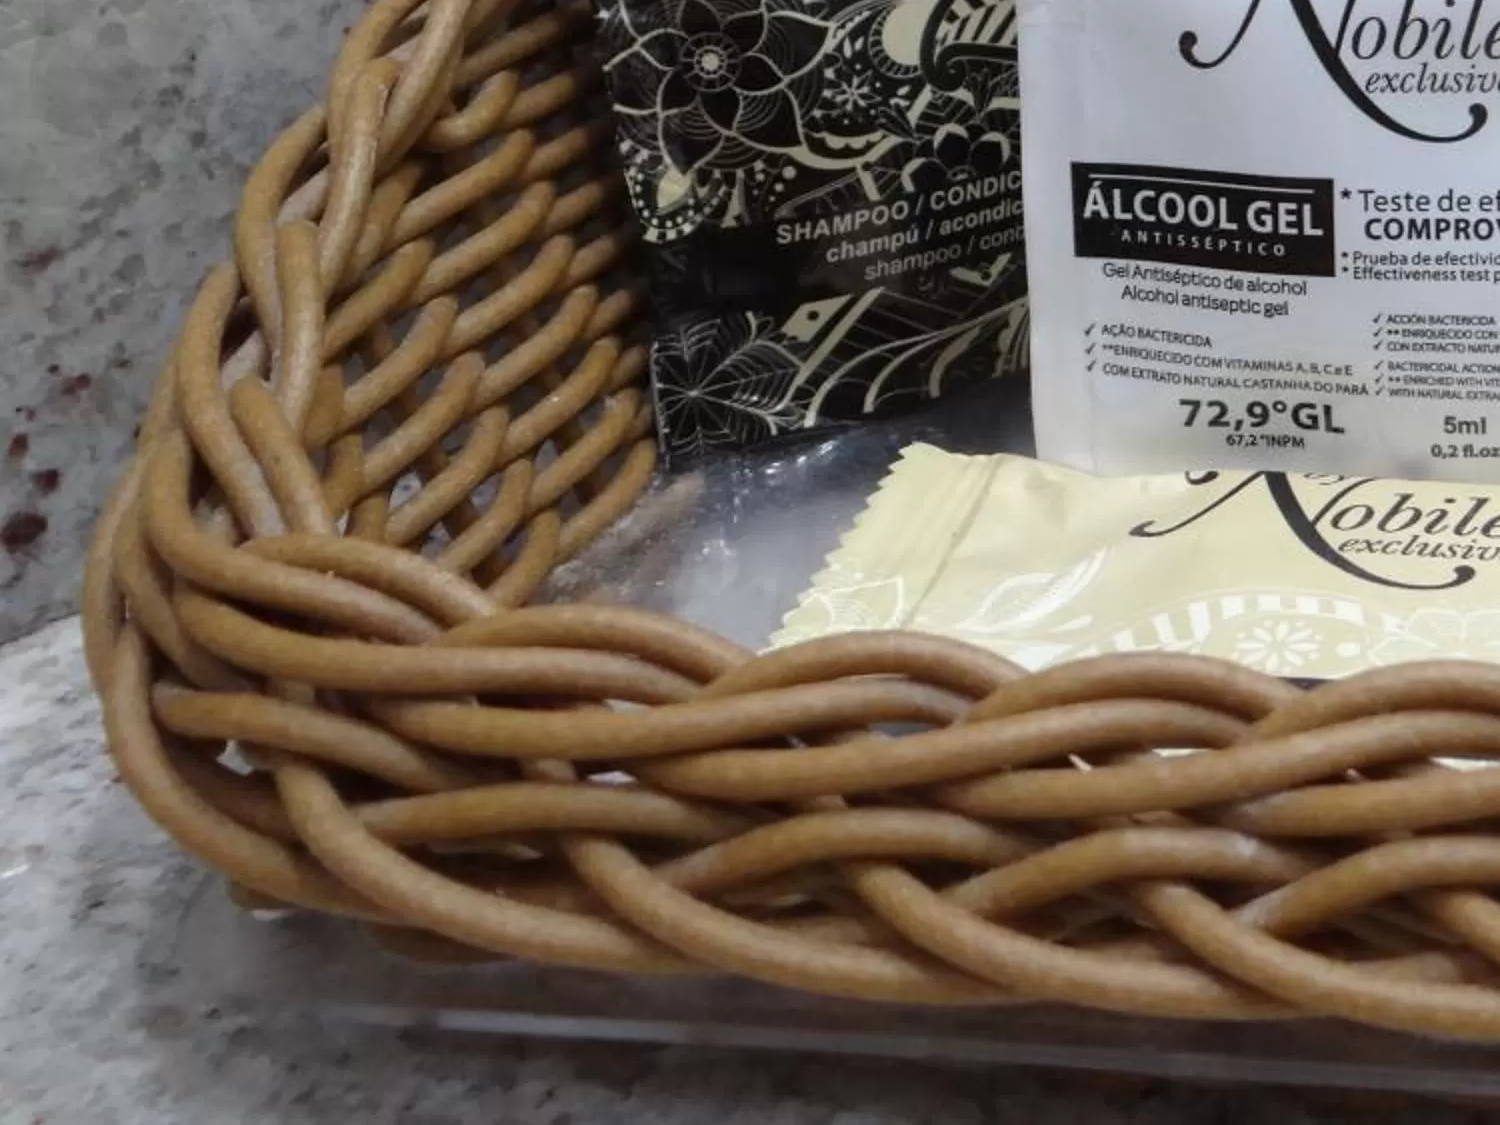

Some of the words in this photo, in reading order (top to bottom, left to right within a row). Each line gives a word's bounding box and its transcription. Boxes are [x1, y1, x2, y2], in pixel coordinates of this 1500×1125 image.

[1083, 180, 1239, 231] ÁLCOOL
[1246, 200, 1325, 237] GEL
[1357, 189, 1432, 213] Teste
[1436, 188, 1472, 213] de
[775, 200, 909, 245] SHAMPOO
[825, 224, 919, 263] champú
[1121, 228, 1286, 257] ANTISSÉPTICO
[1352, 250, 1408, 266] Prueba
[1411, 250, 1431, 266] de
[863, 242, 961, 281] shampoo
[1352, 266, 1457, 281] Effectiveness
[1460, 268, 1489, 281] test
[1102, 262, 1131, 278] Gel
[1223, 274, 1245, 290] de
[1246, 278, 1308, 296] alcohol
[1121, 284, 1179, 306] Alcohol
[1181, 293, 1262, 316] antiseptic
[1263, 301, 1289, 318] gel
[1178, 398, 1346, 434] 72,9°GL
[1443, 415, 1487, 435] 5ml
[1430, 443, 1459, 460] 0,2
